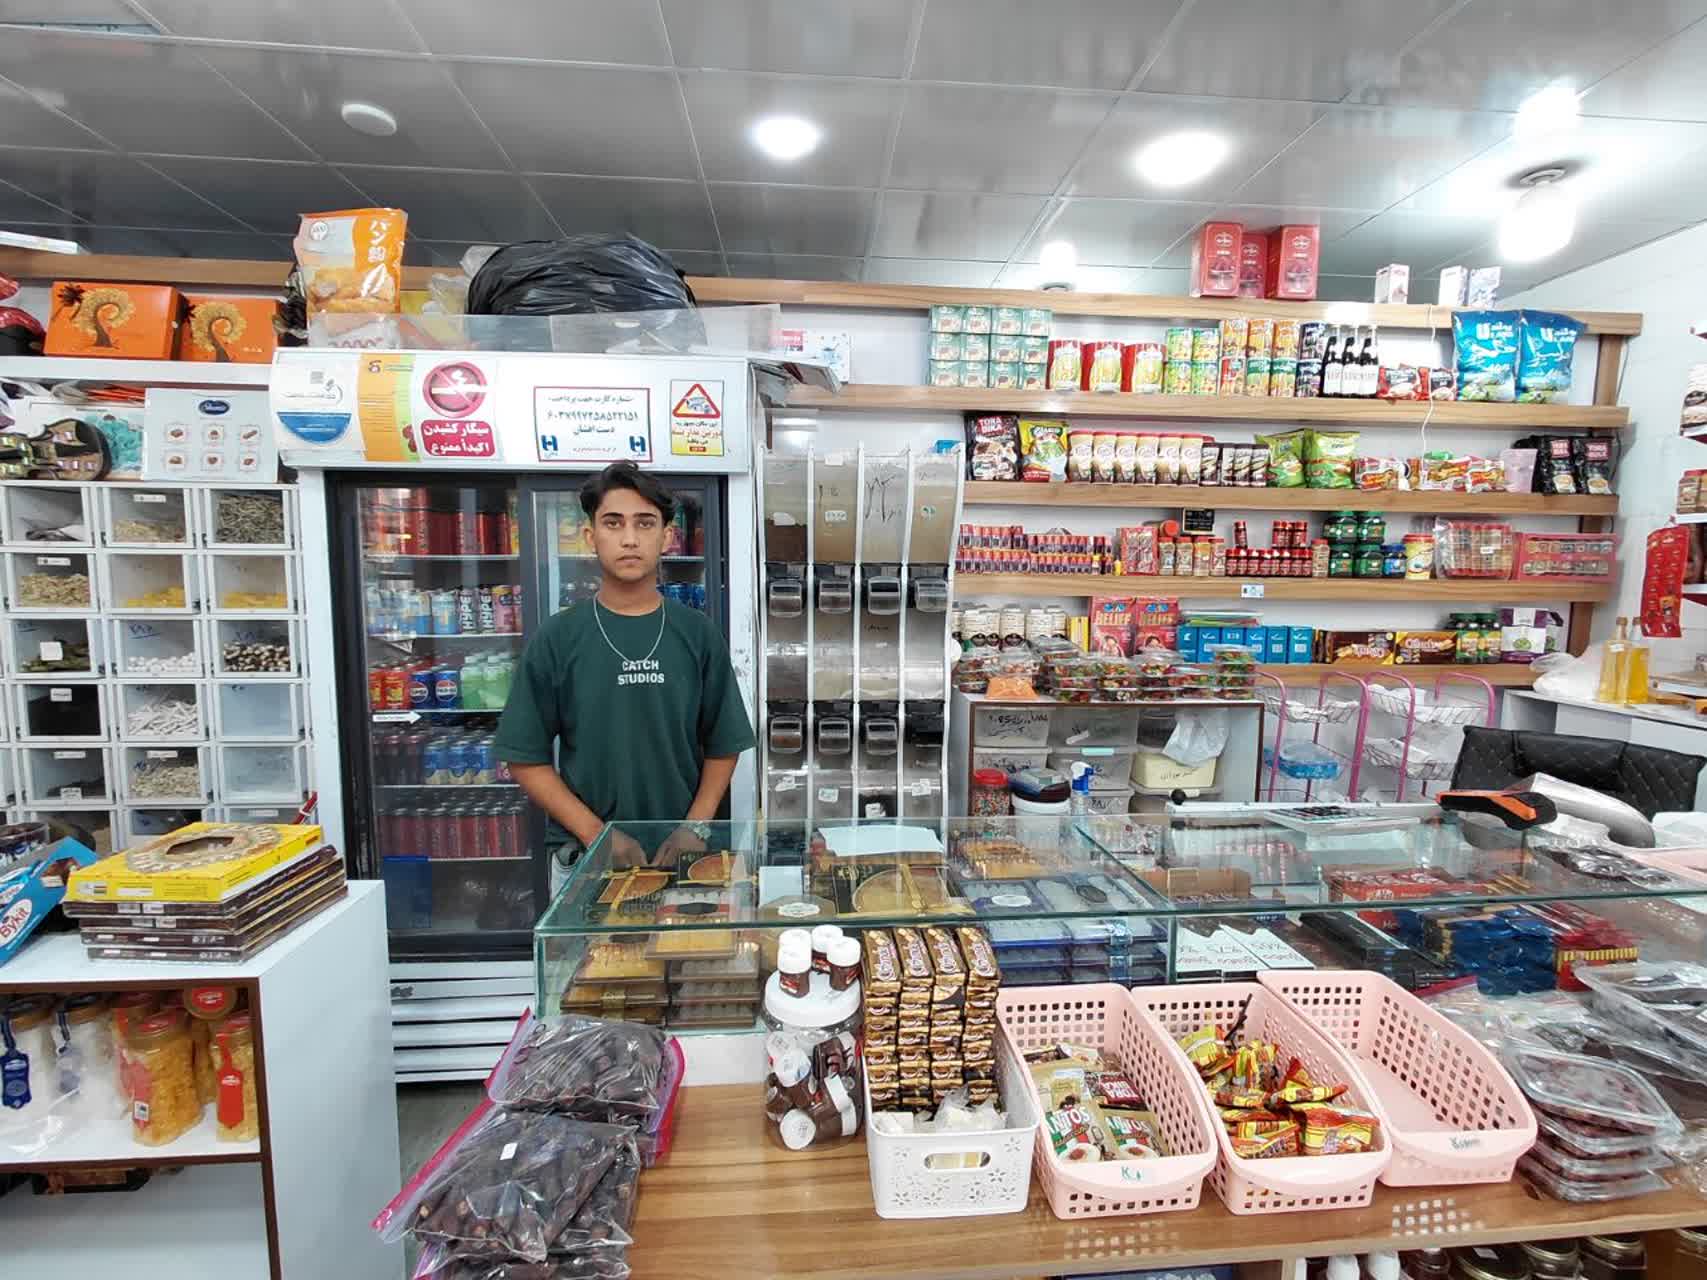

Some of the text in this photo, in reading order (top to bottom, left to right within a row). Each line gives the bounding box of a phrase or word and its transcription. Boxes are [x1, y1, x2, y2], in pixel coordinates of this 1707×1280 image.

[423, 422, 489, 437] سیگار کشیدن
[431, 442, 461, 456] ممنوع
[460, 595, 473, 629] HYPE
[480, 595, 494, 629] HYPE
[622, 660, 659, 671] CATCH
[617, 672, 665, 685] STUDIOS
